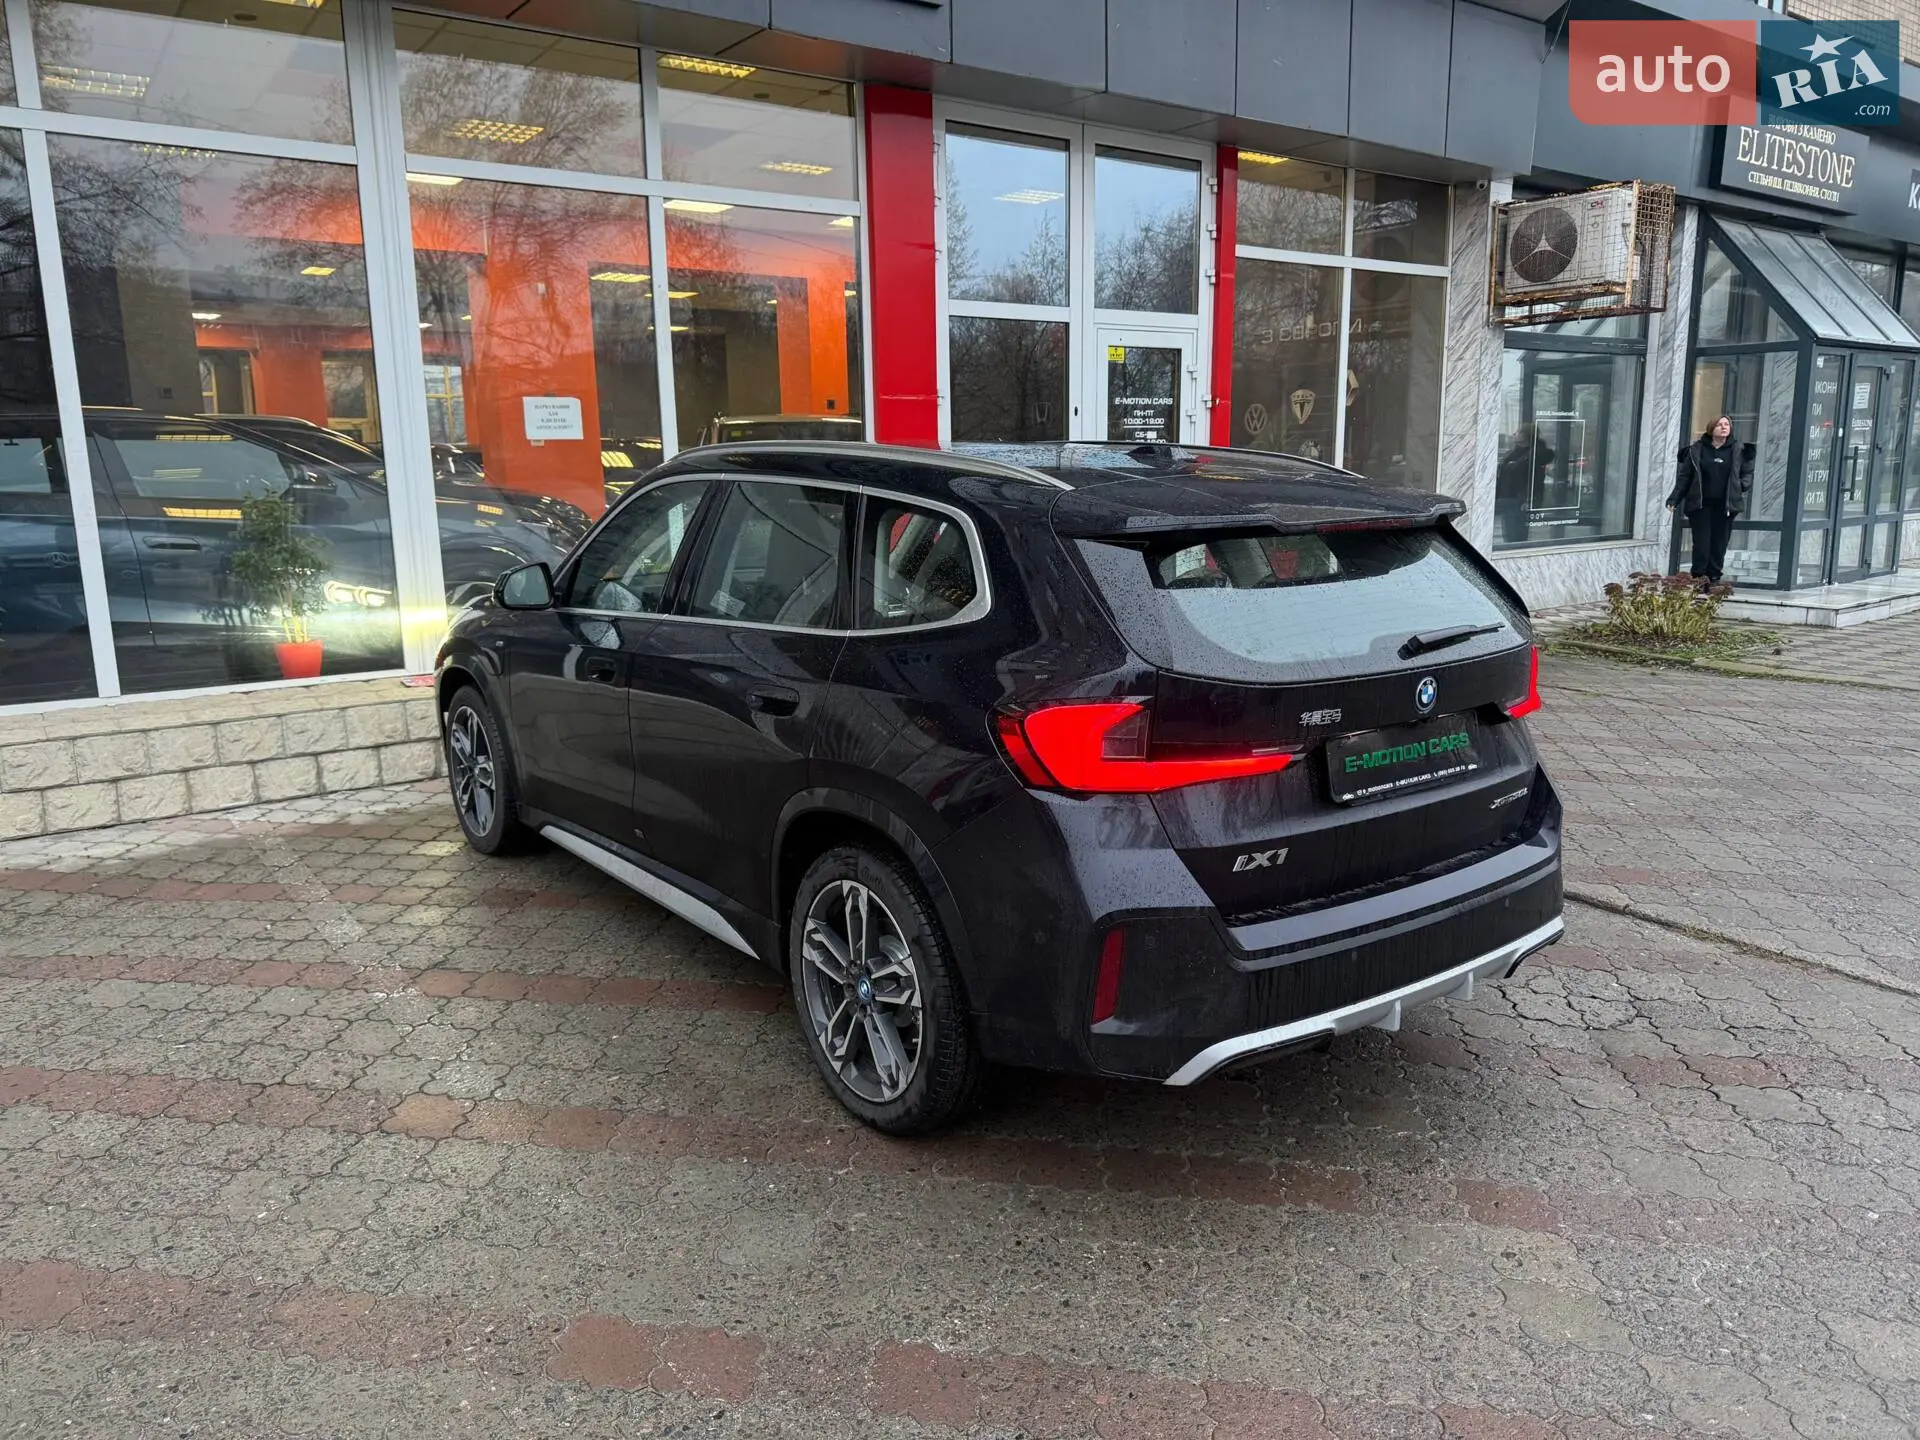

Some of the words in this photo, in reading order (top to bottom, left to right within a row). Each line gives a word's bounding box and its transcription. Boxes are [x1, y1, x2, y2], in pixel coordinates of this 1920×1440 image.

[1737, 126, 1856, 188] ELITESTONE
[1114, 397, 1152, 405] E-MOTION
[1153, 397, 1174, 405] CARS
[1344, 741, 1427, 773] E-MOTION
[1428, 732, 1470, 754] CARS
